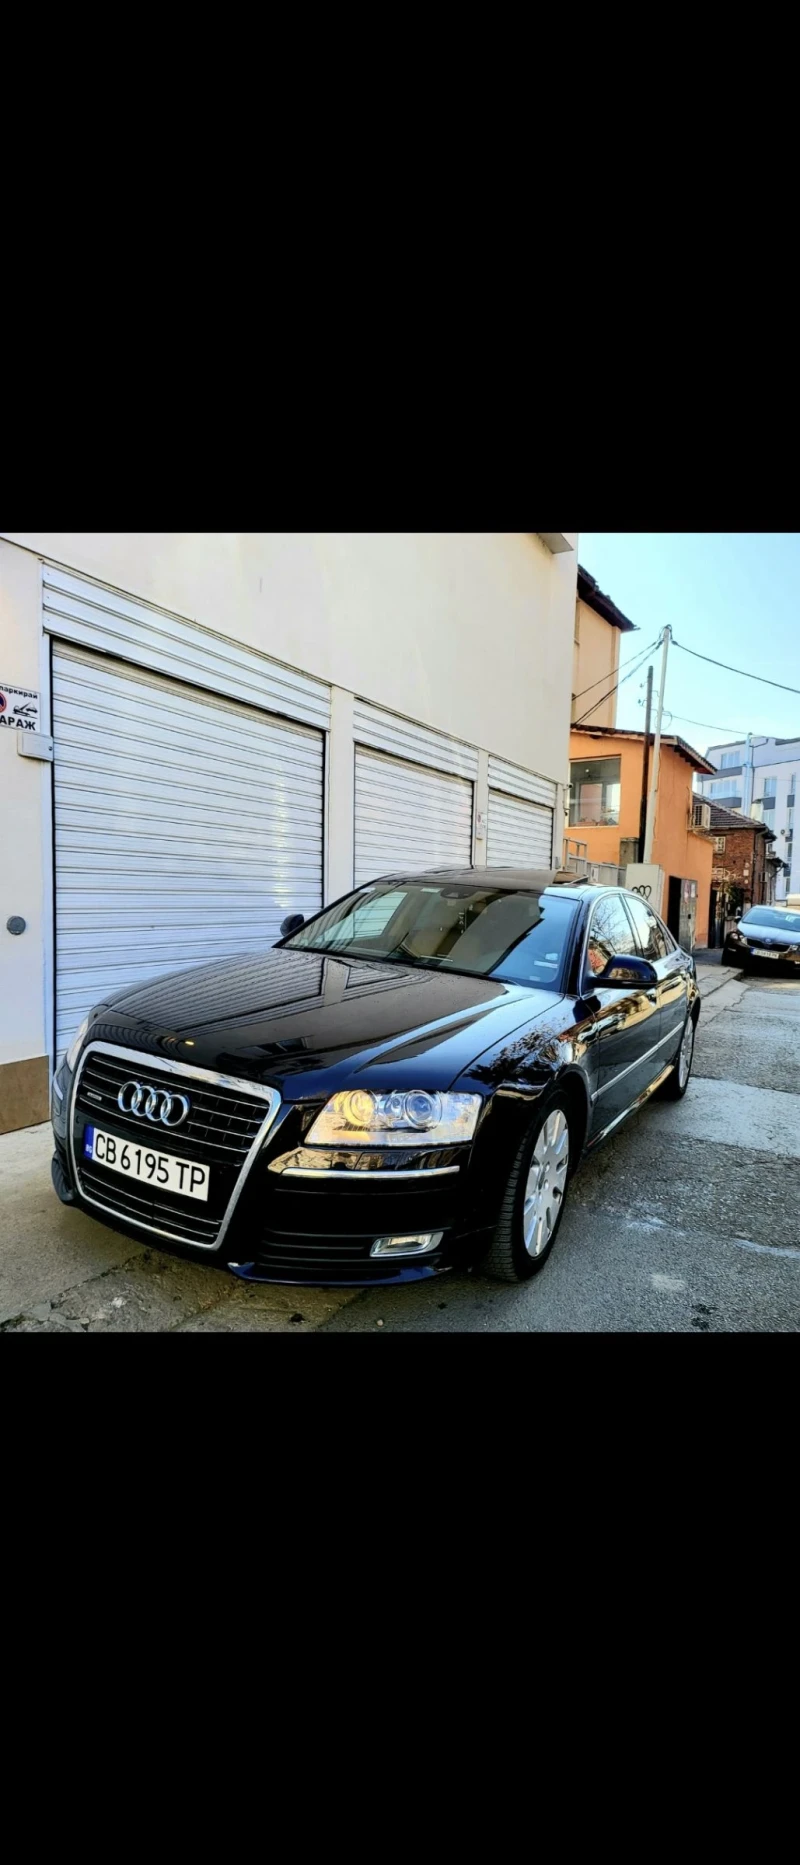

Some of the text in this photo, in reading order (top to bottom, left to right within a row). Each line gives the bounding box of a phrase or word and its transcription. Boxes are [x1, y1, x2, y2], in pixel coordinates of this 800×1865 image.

[95, 1133, 206, 1193] CB 6195 TP
